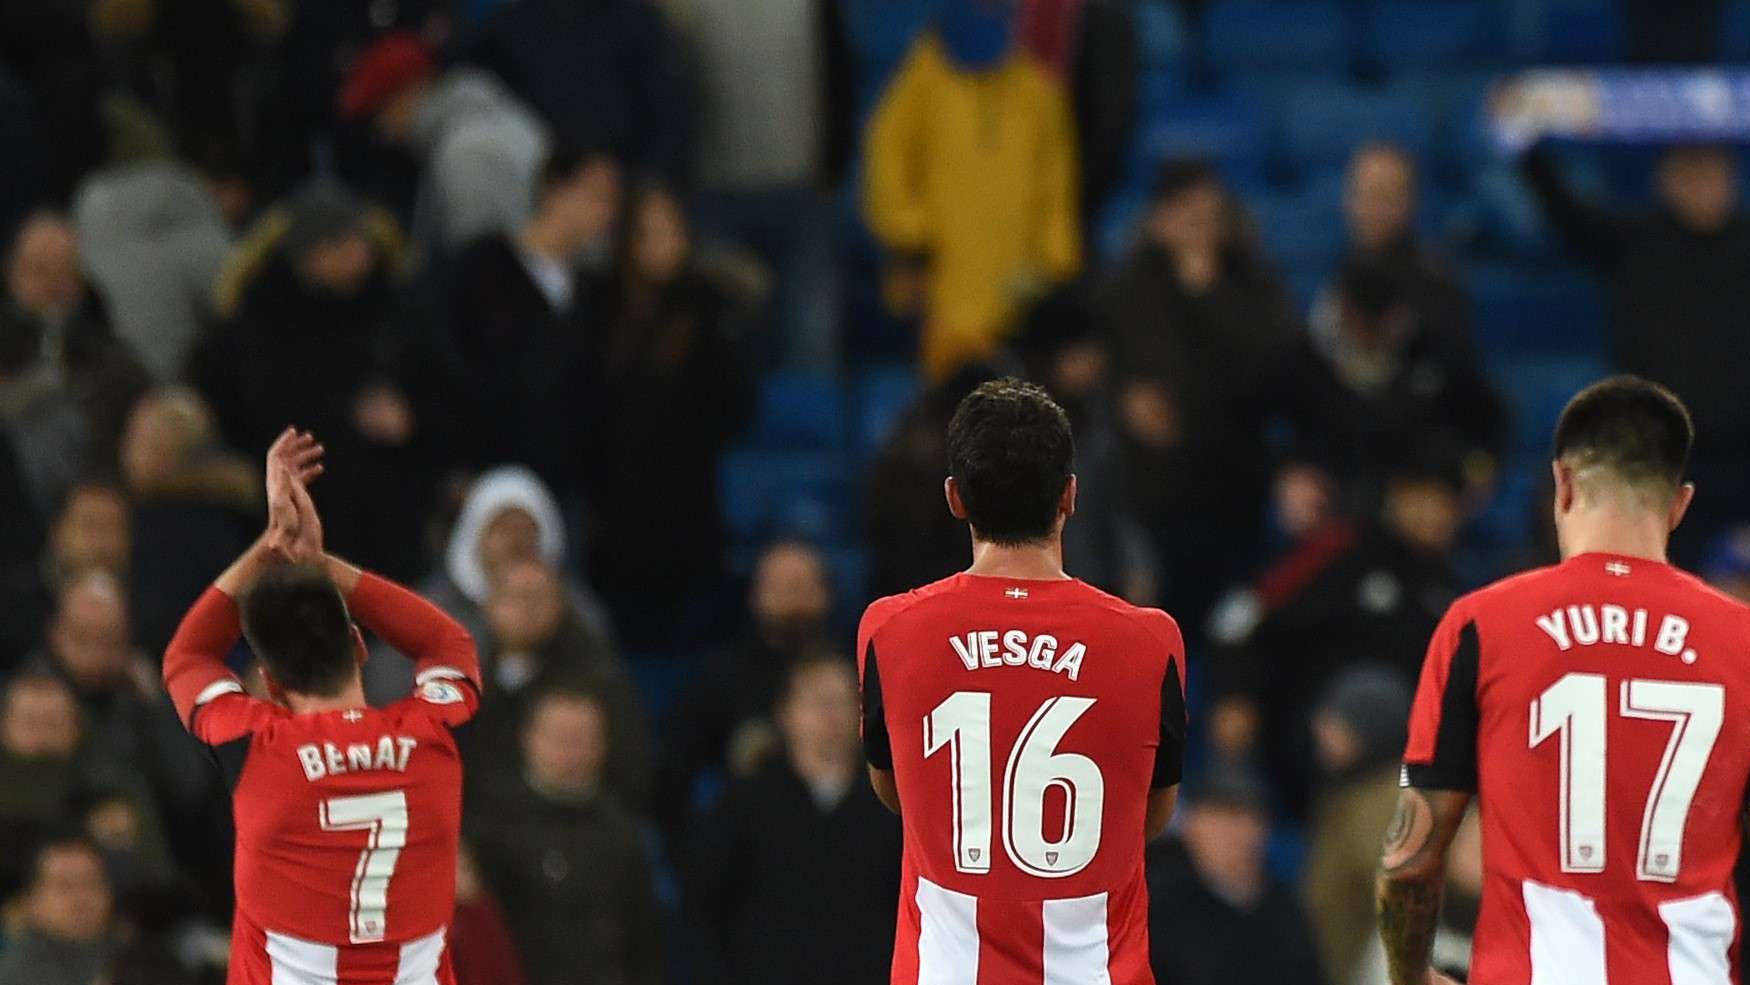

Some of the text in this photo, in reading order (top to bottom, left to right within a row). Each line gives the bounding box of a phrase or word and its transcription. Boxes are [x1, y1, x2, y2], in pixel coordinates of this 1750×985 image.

[950, 630, 1087, 681] VESGA
[1536, 604, 1698, 665] YURI B.
[922, 691, 1104, 878] 16
[1528, 672, 1726, 884] 17
[319, 790, 408, 944] 7
